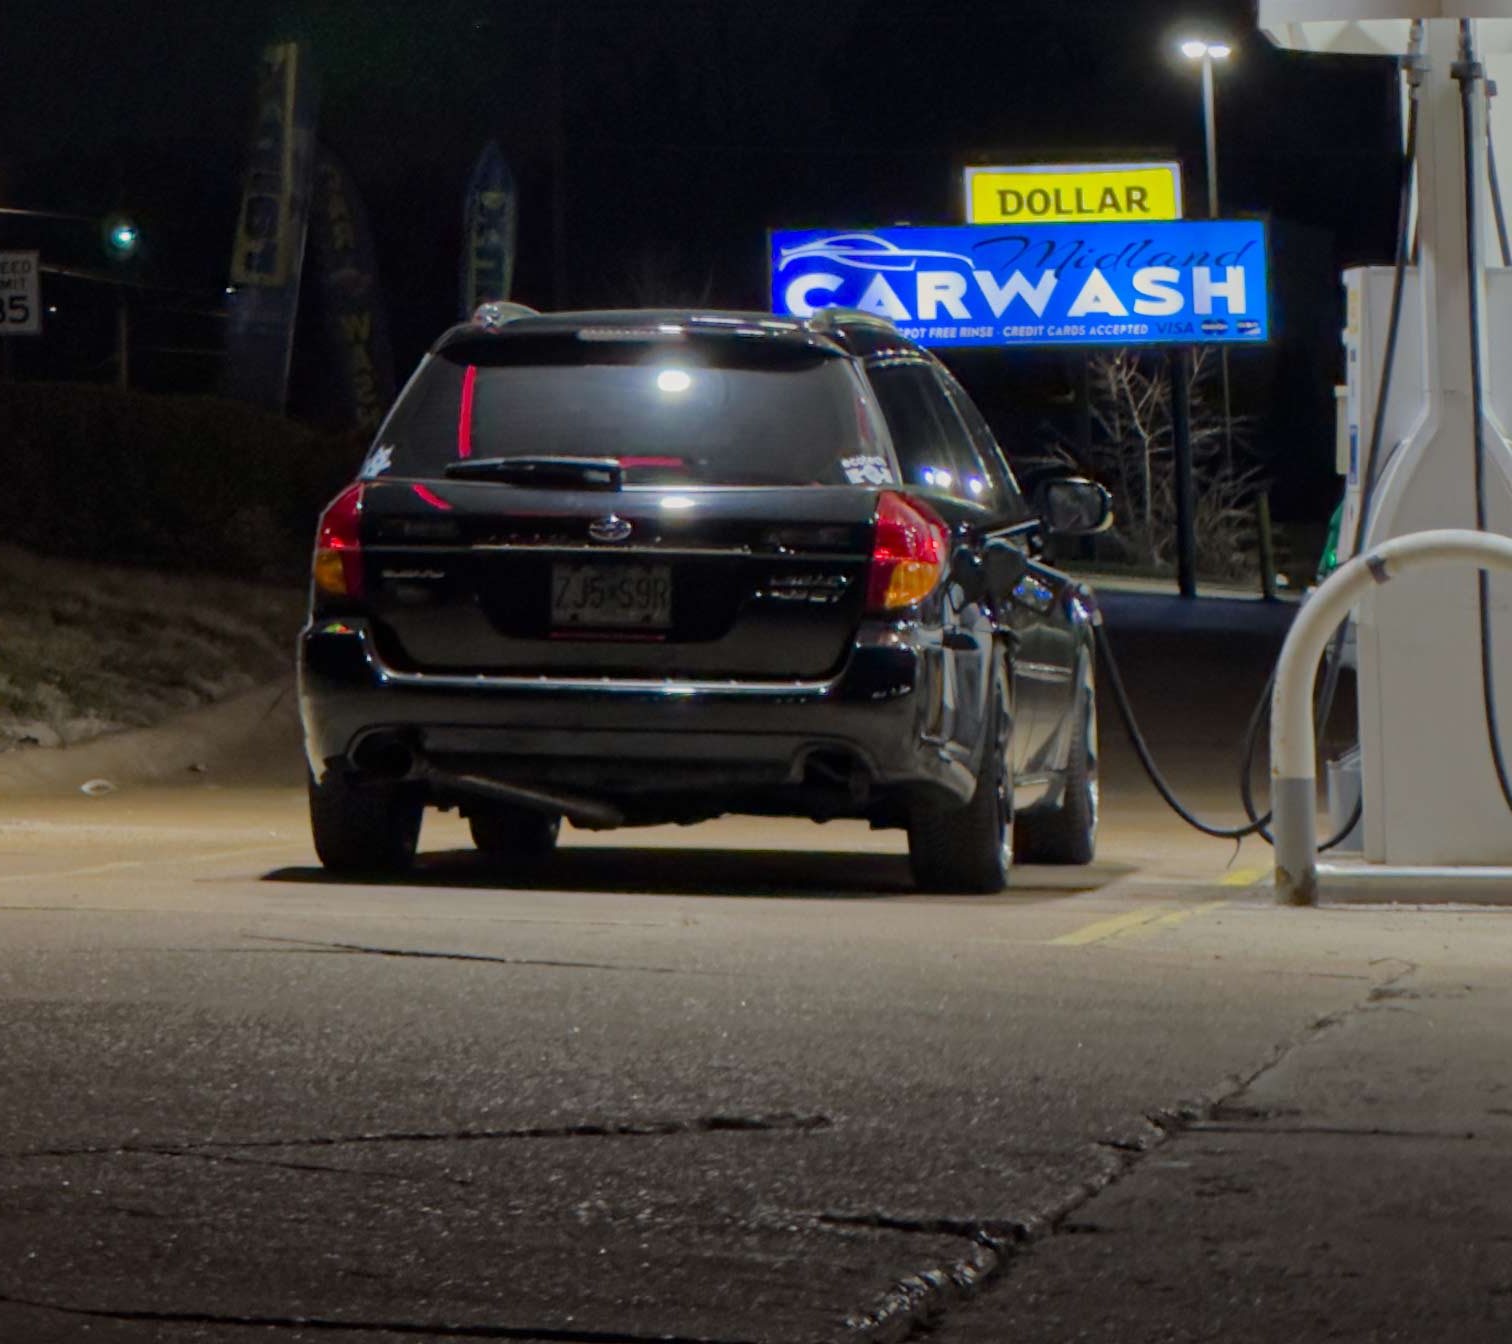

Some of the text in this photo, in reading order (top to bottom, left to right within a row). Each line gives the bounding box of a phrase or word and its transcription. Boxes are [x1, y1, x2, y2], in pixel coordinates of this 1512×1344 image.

[997, 184, 1151, 216] DOLLAR
[972, 235, 1257, 282] Midland
[785, 265, 1247, 321] CARWASH
[928, 326, 957, 339] FREE
[959, 326, 994, 338] RINSE
[1002, 325, 1046, 338] CREDIT
[1047, 325, 1086, 337] CARDS
[1088, 323, 1149, 336] ACCEPTED
[1155, 321, 1195, 335] VISA
